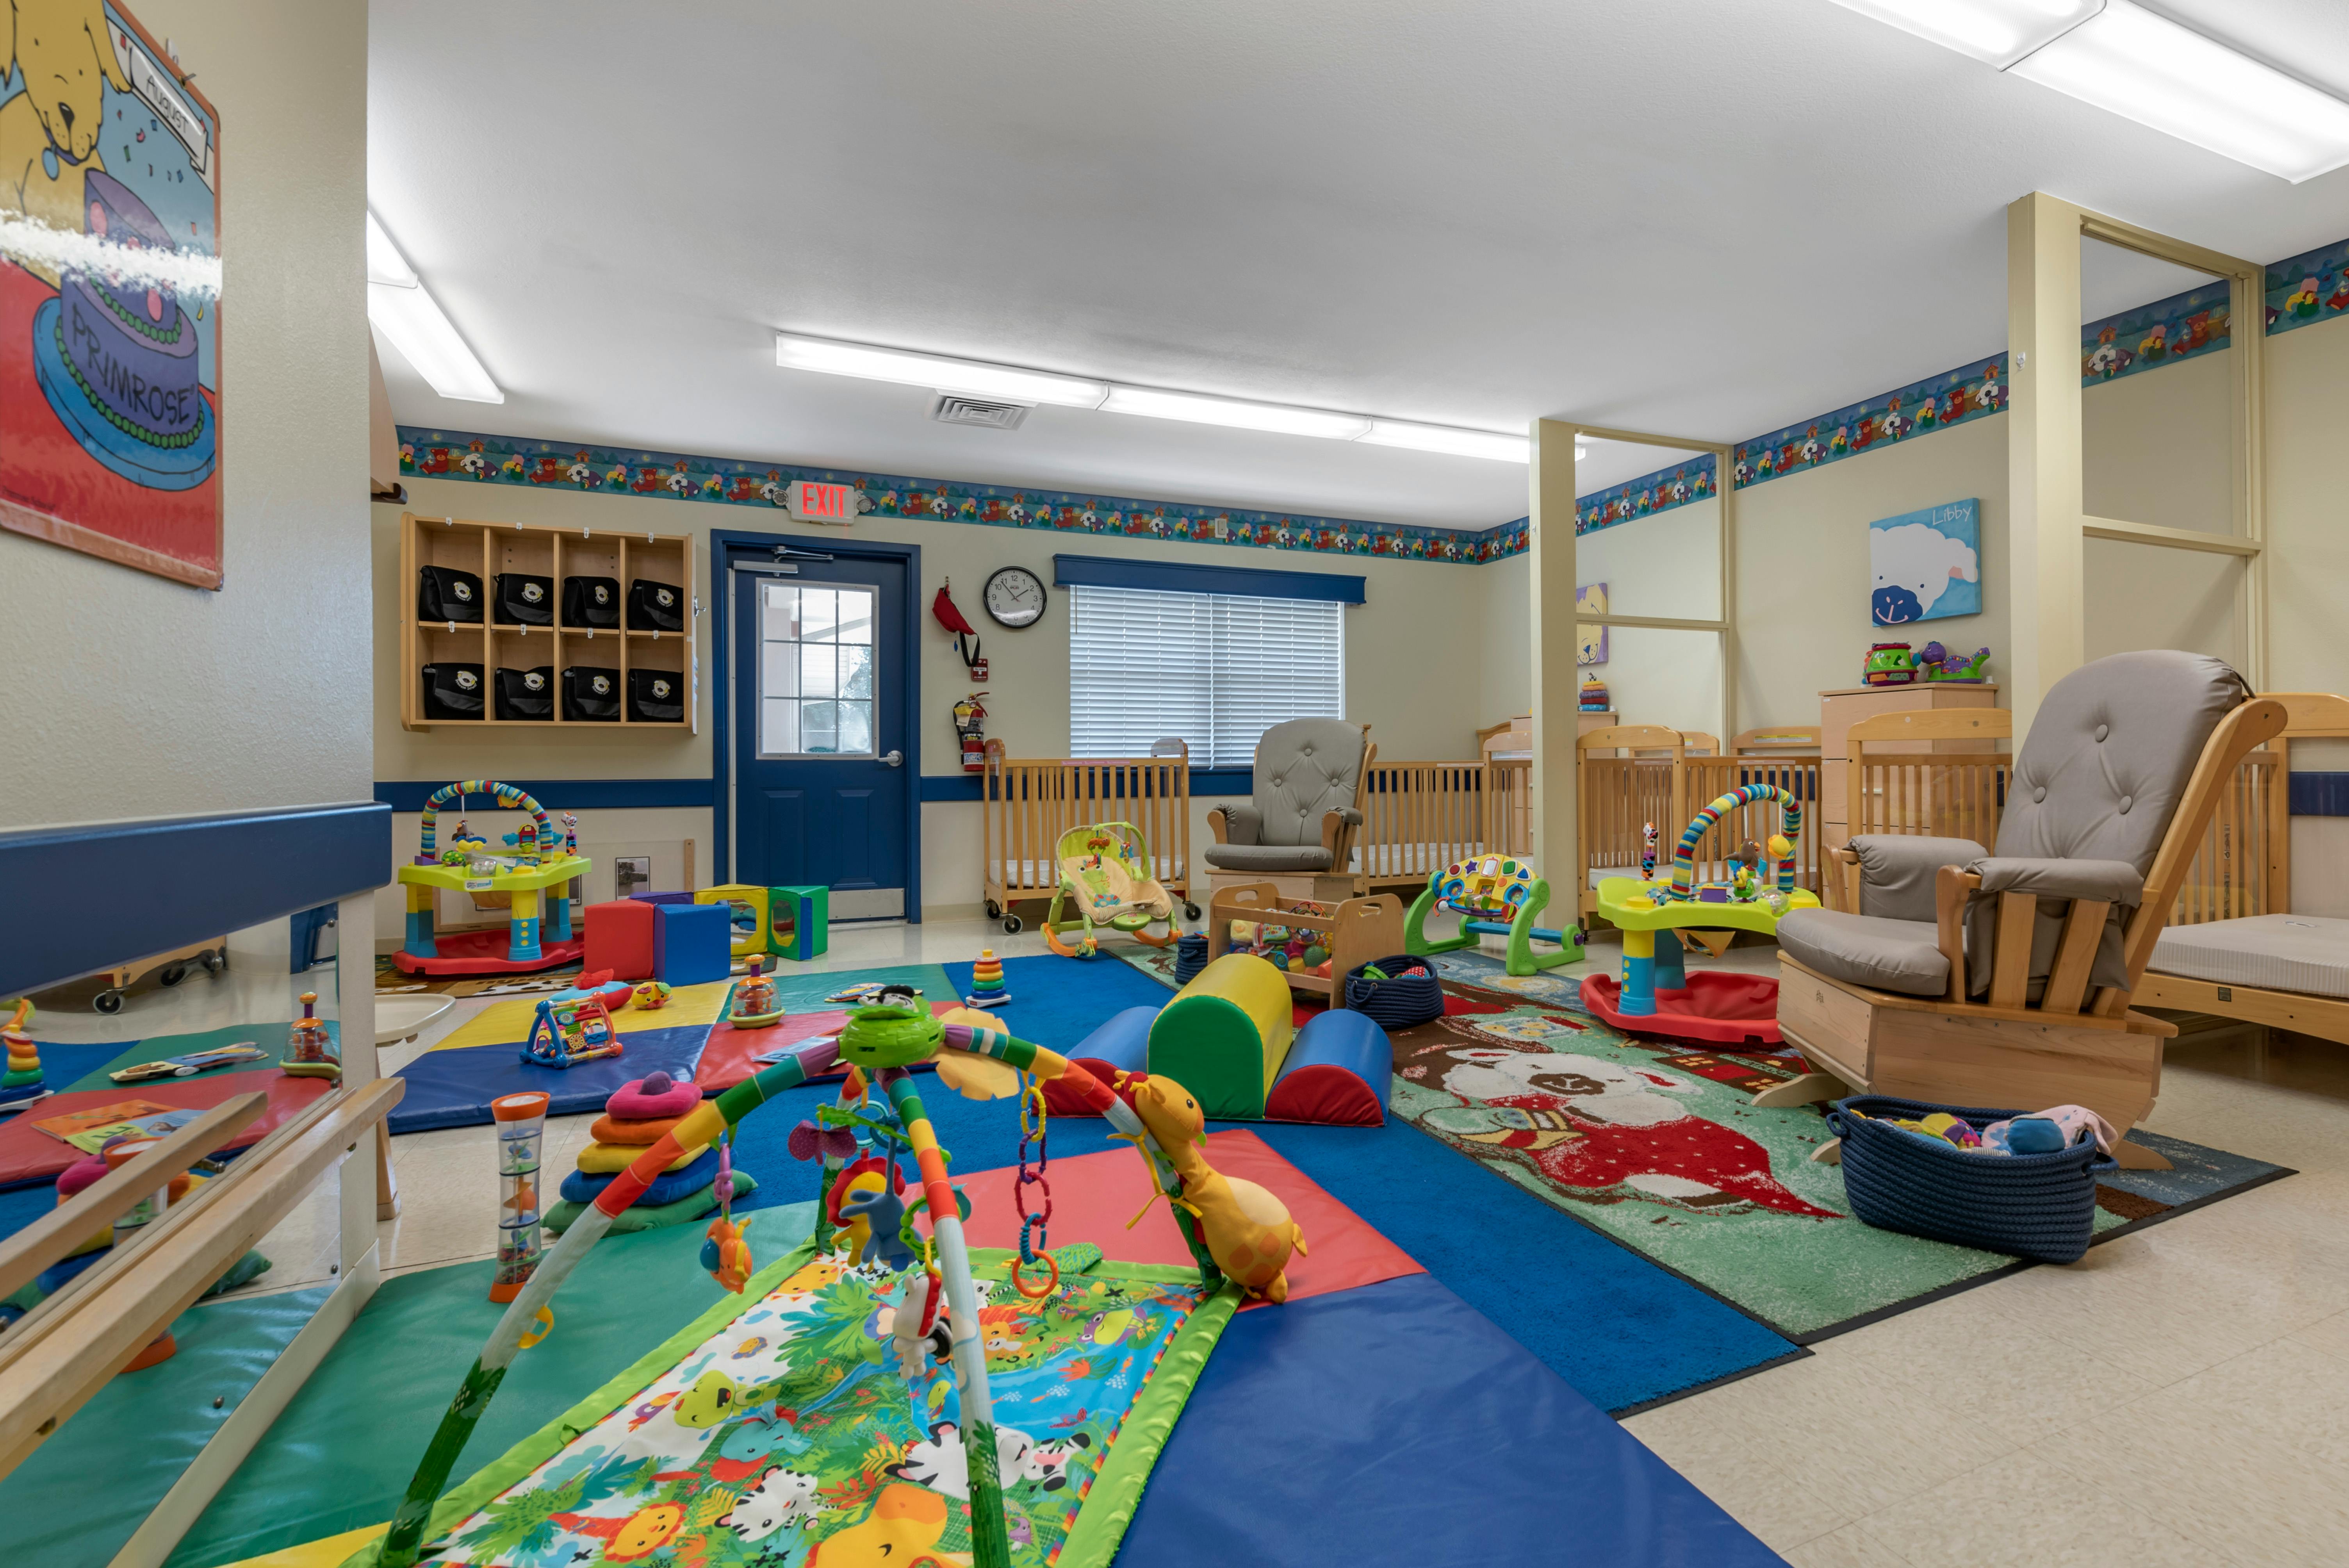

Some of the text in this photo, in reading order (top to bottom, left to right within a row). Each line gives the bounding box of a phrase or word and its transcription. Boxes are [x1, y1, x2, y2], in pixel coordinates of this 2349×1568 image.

[146, 75, 189, 134] August
[802, 483, 847, 518] EXIT
[1933, 506, 1971, 525] Libby
